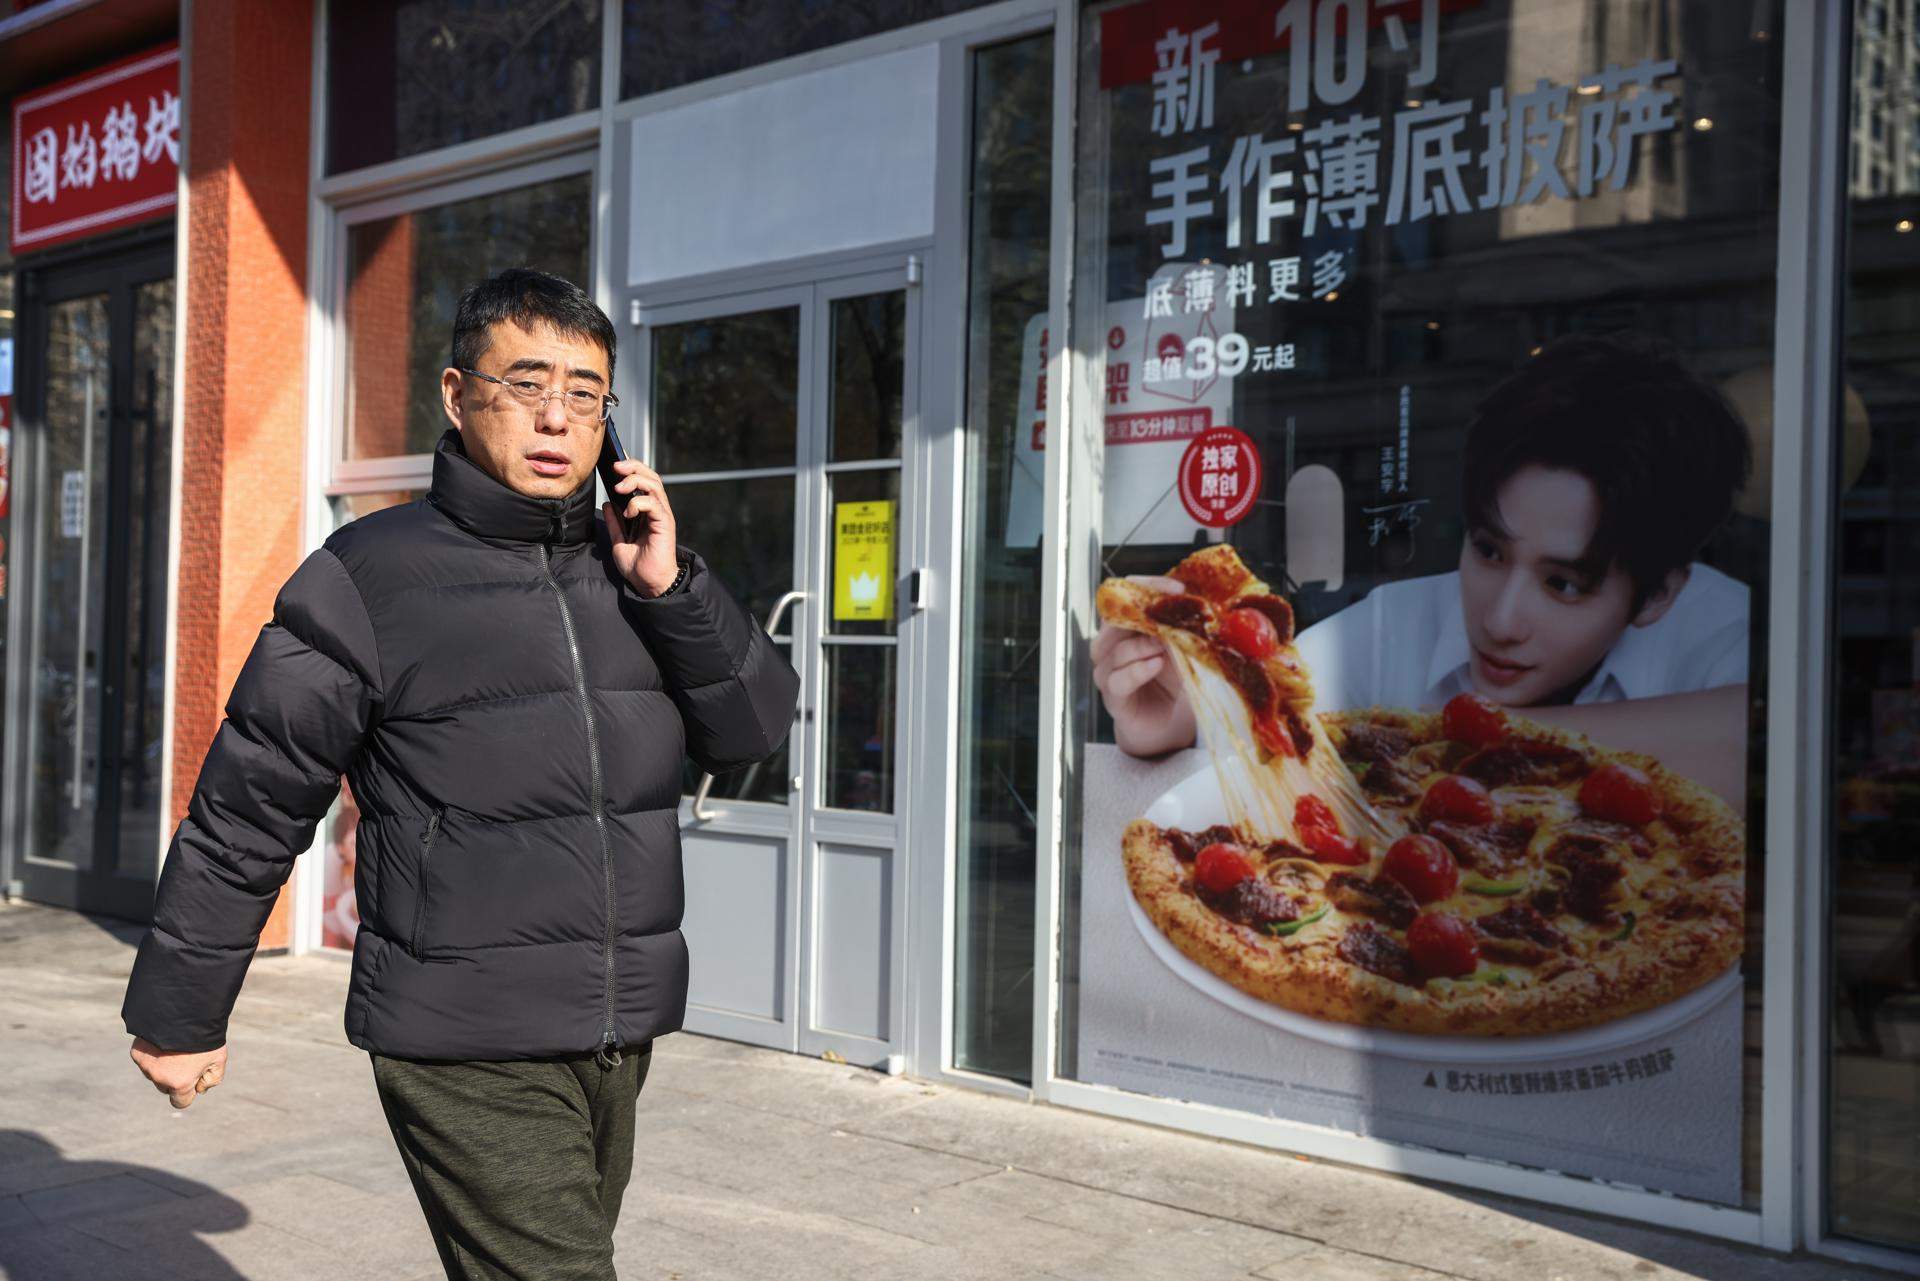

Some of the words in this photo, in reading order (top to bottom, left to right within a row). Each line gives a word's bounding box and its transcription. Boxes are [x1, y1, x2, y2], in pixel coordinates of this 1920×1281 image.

[1146, 57, 1680, 258] 手作薄底披萨
[1144, 251, 1346, 319] 底薄料更多
[1143, 333, 1295, 383] 超值39元起
